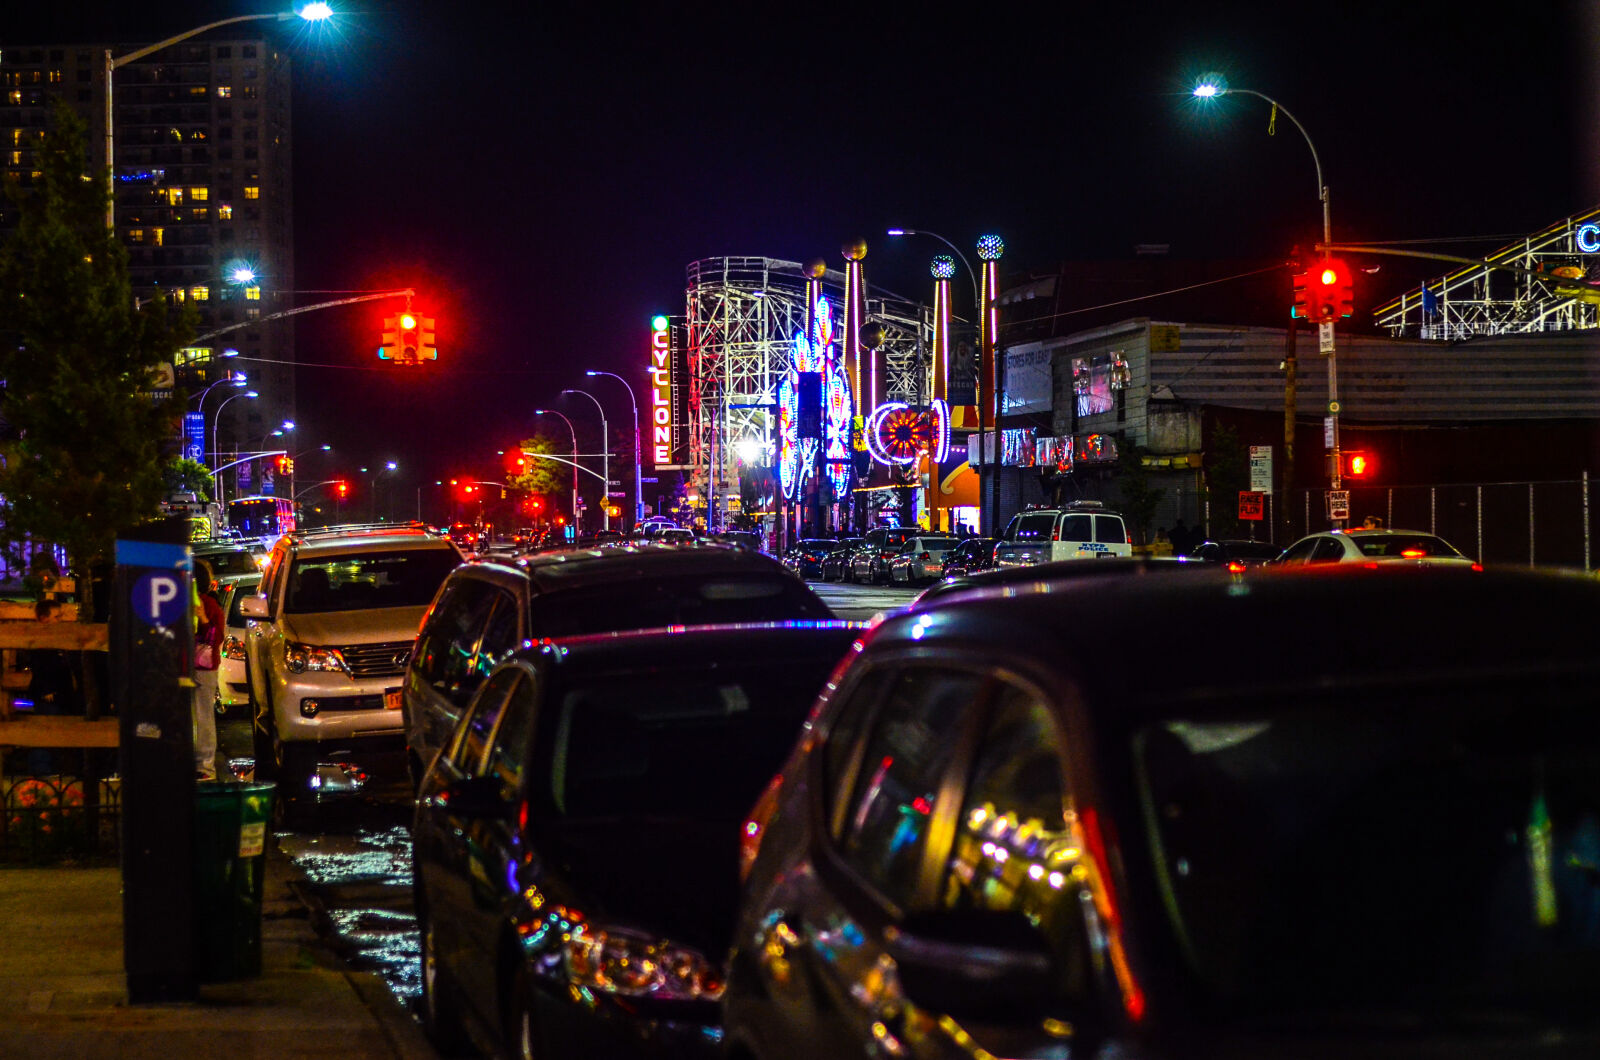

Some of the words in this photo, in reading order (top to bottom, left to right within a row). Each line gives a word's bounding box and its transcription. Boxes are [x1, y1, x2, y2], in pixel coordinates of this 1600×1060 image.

[653, 330, 670, 464] CYCLONE
[1331, 491, 1346, 500] PARK
[1331, 500, 1348, 509] HERE
[150, 576, 178, 618] P
